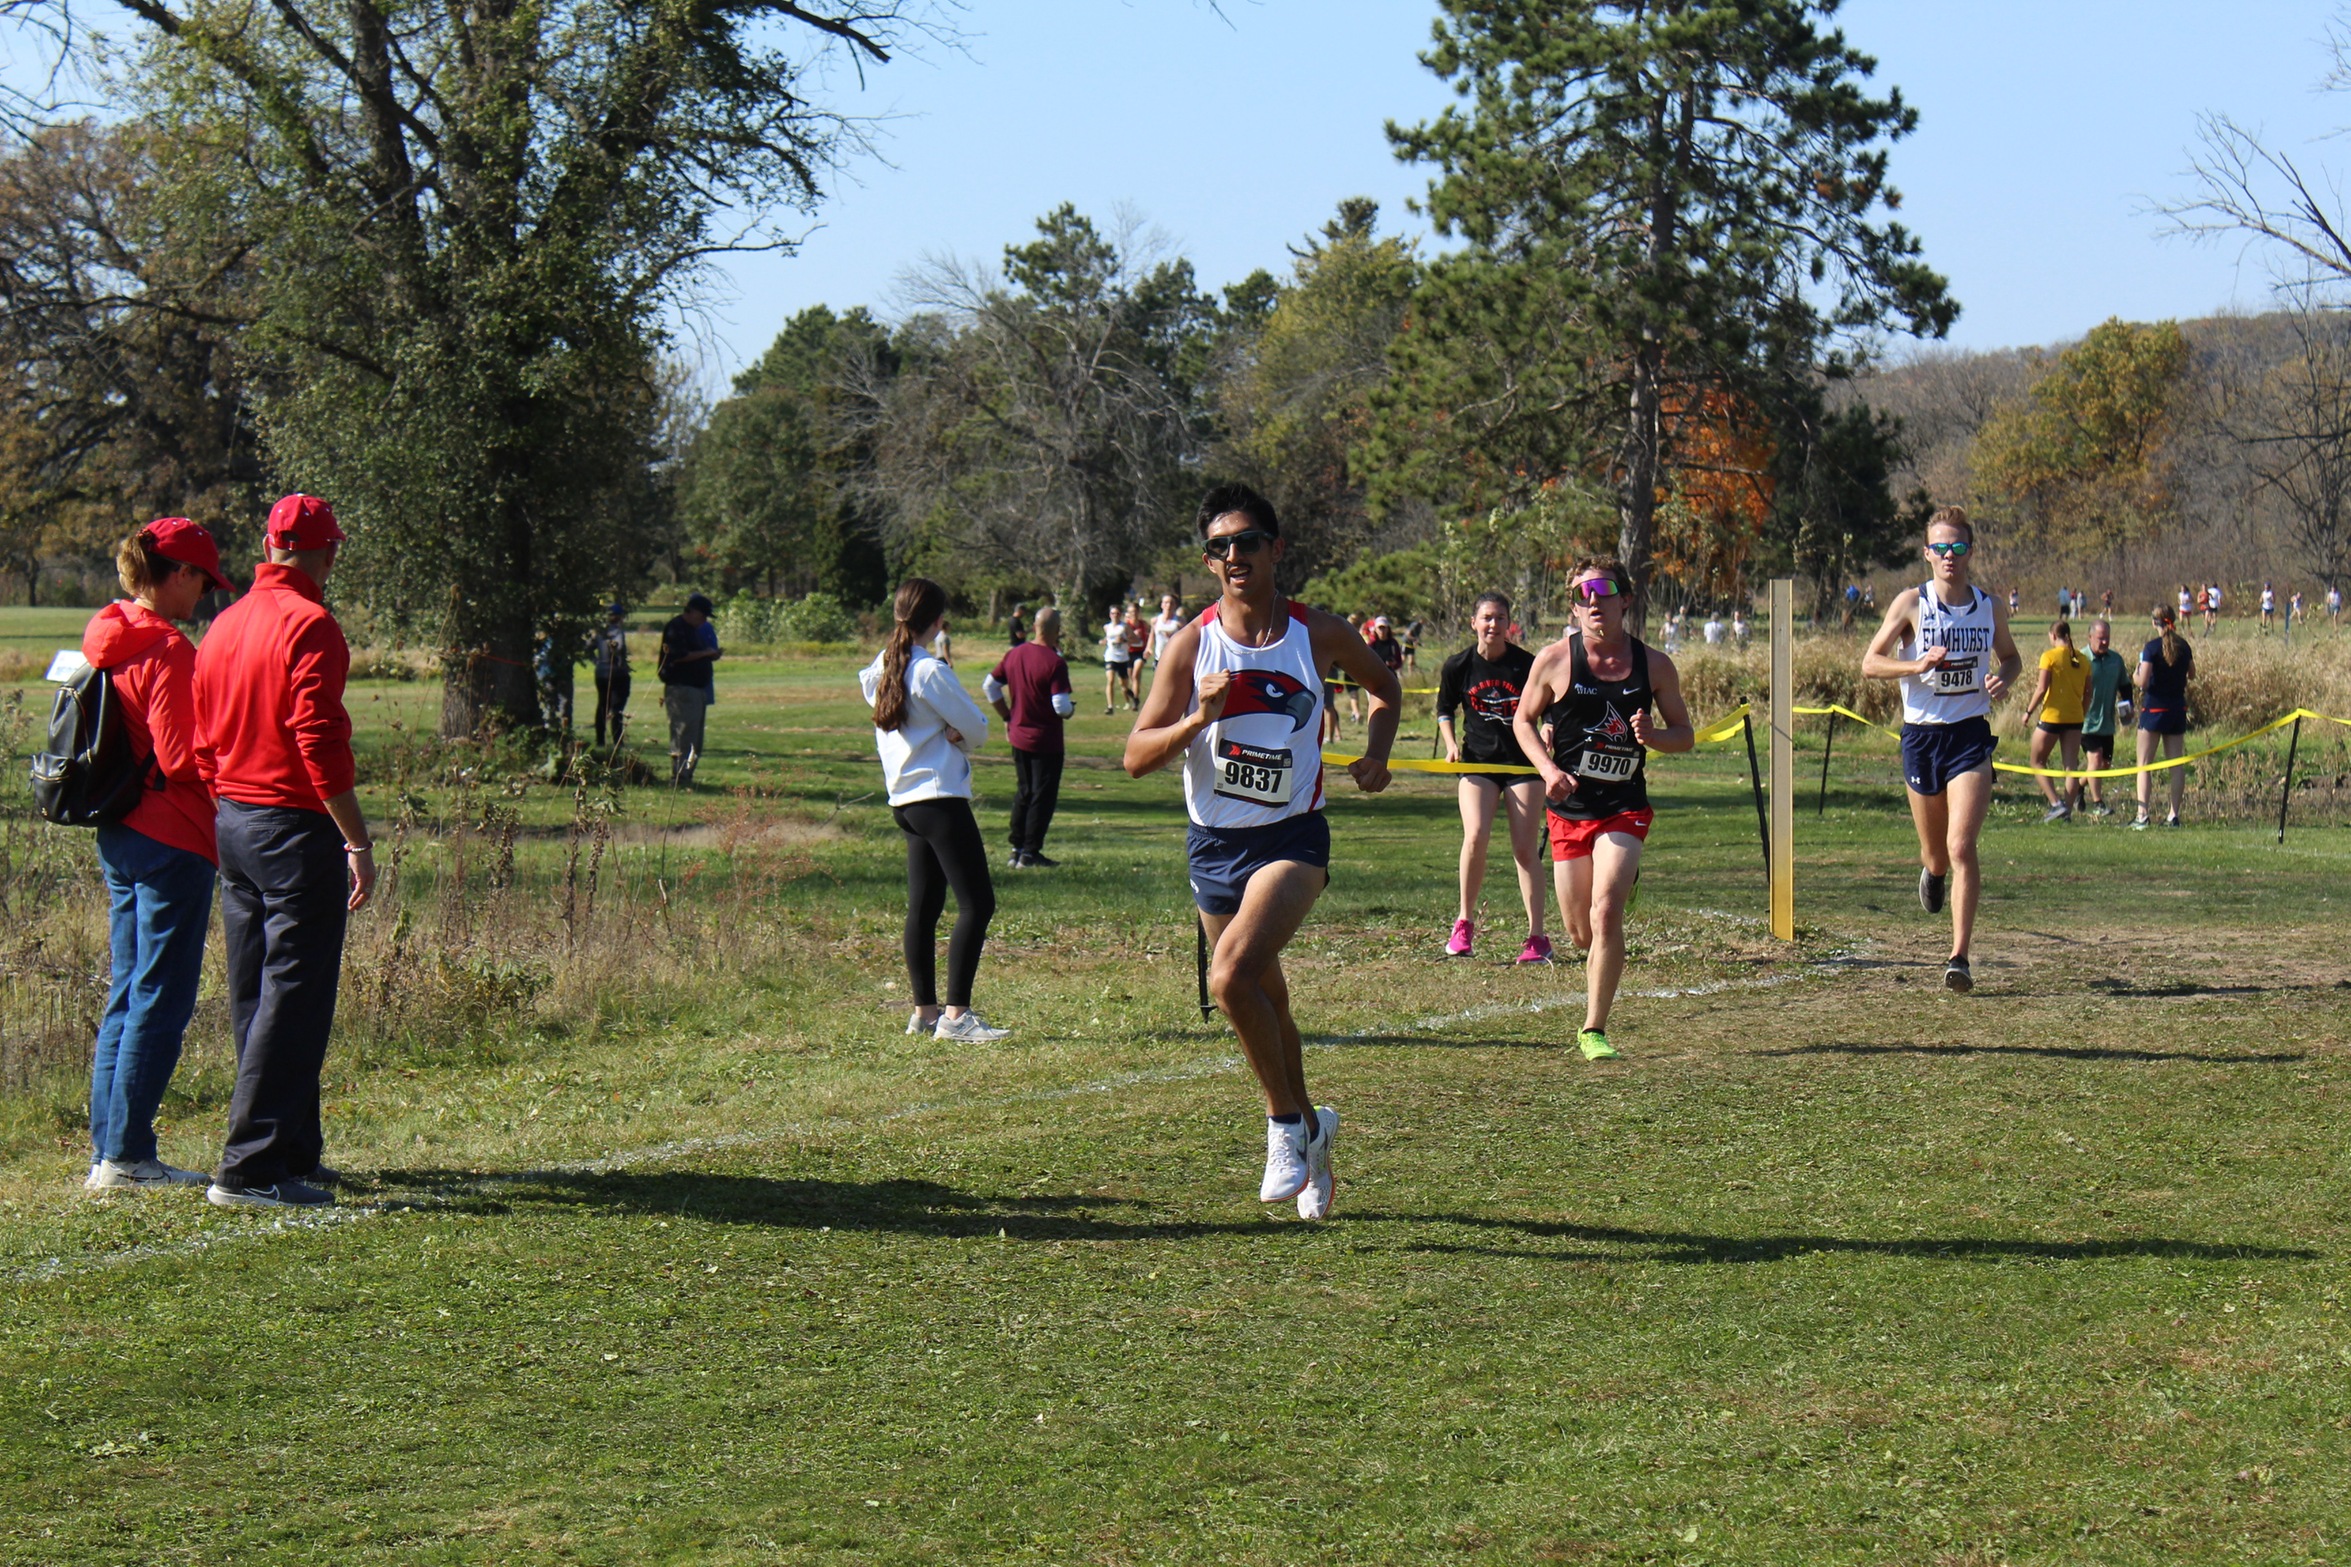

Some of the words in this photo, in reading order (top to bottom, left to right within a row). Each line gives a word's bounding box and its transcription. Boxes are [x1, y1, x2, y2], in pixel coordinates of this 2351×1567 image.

[1922, 628, 1990, 652] ELMHURST
[1941, 670, 1973, 687] 9478
[1575, 686, 1598, 695] WIAC
[1241, 749, 1283, 760] PRIMETIME
[1587, 753, 1631, 776] 9970
[1224, 761, 1283, 793] 9837
